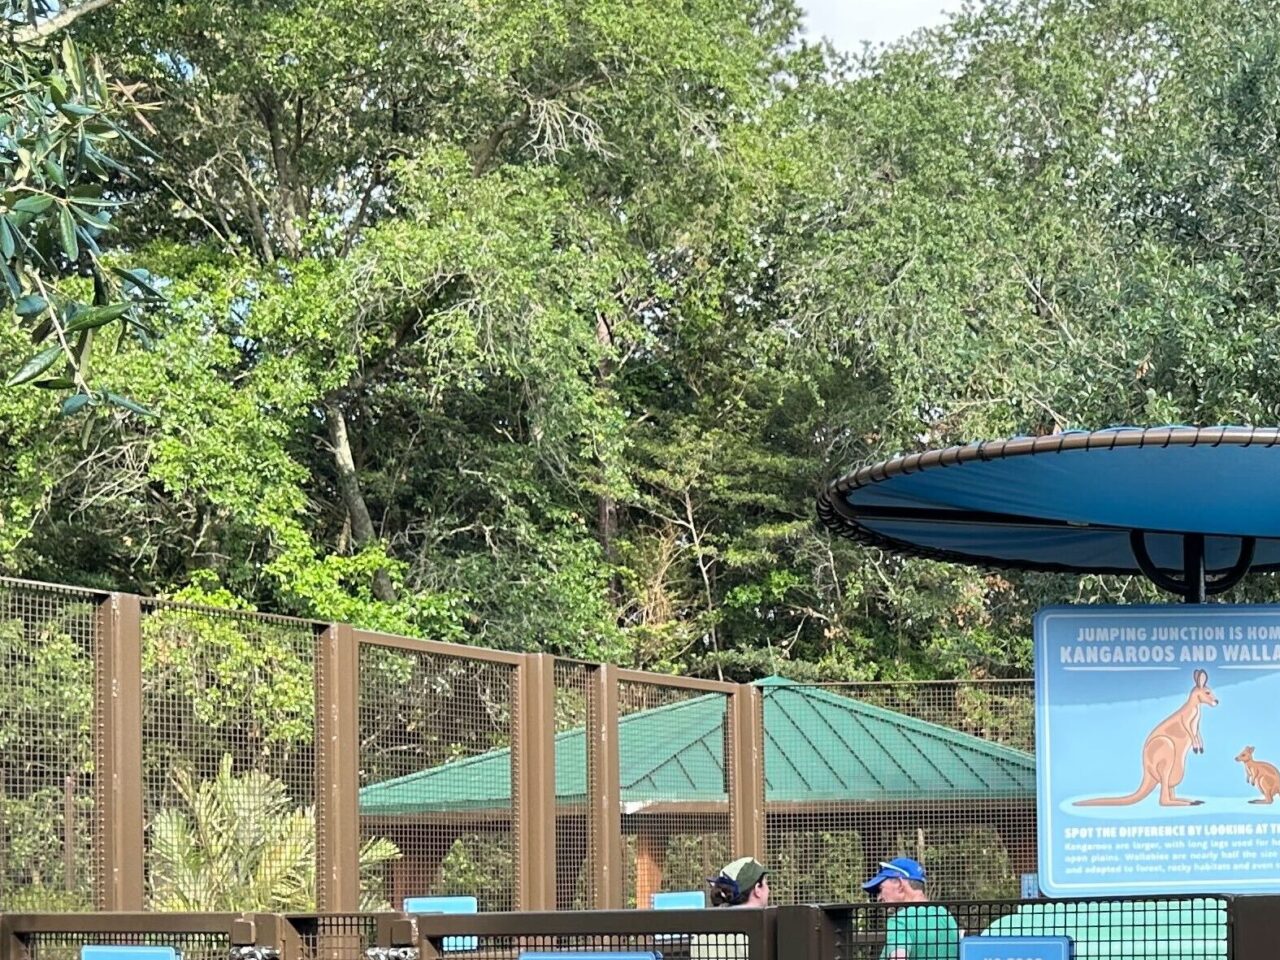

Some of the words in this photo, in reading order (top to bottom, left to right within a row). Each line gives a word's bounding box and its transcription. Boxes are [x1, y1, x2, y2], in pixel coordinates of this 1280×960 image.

[1077, 627, 1147, 642] JUMPING
[1151, 626, 1225, 642] JUNCTION
[1229, 626, 1243, 640] IS
[1060, 645, 1175, 664] KANGAROOS
[1180, 644, 1218, 663] AND
[1064, 827, 1093, 839] SPOT
[1095, 826, 1117, 838] THE
[1119, 825, 1185, 838] DIFFERENCE
[1187, 824, 1203, 837] BY
[1204, 823, 1253, 836] LOOKING
[1255, 823, 1269, 834] AT
[1064, 842, 1113, 852] Kangaroos
[1132, 841, 1162, 851] larger,
[1164, 840, 1186, 849] with
[1188, 840, 1208, 850] long
[1231, 839, 1253, 847] used
[1255, 838, 1269, 847] for
[1064, 855, 1088, 864] open
[1124, 852, 1169, 861] Wallabies
[1190, 851, 1218, 861] nearly
[1221, 850, 1240, 859] half
[1242, 850, 1257, 858] the
[1260, 850, 1278, 858] size
[1065, 866, 1083, 874] and
[1084, 865, 1121, 875] adapted
[1123, 865, 1134, 873] to
[1167, 863, 1192, 873] rocky
[1194, 862, 1230, 872] habitats
[1232, 862, 1250, 870] and
